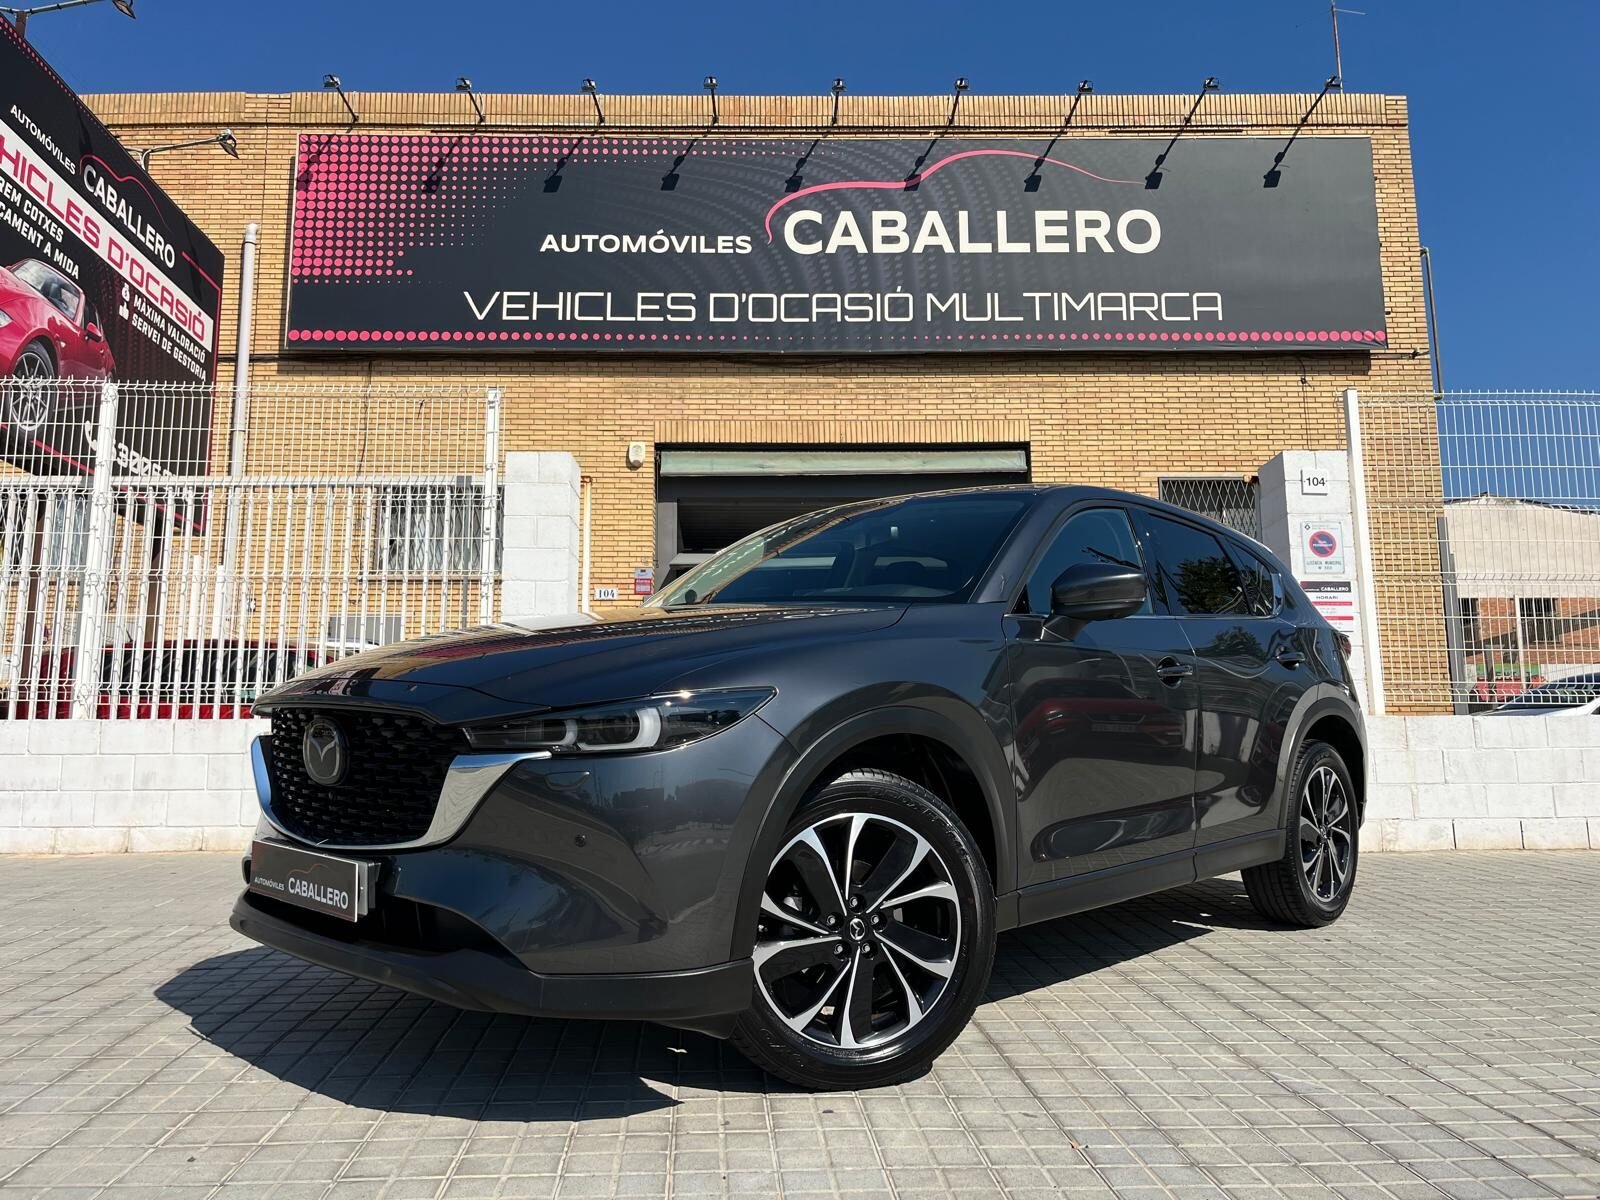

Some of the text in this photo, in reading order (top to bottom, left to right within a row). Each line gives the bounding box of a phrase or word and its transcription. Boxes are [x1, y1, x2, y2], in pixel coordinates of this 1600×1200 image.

[11, 104, 175, 269] AUTOMÓVILES CABALLERO
[23, 200, 64, 243] COTXES
[539, 209, 1162, 255] AUTOMÓVILES CABALLERO
[43, 241, 52, 257] A
[54, 248, 79, 280] MIDA
[107, 236, 205, 343] D'OCASIÓ
[464, 286, 1223, 323] VEHICLES D'OCASIÓ MULTIMARCA
[131, 313, 206, 382] SERVEI DE GESTORIA
[167, 322, 206, 364] VALORACIÓ
[1306, 477, 1326, 487] 104
[599, 589, 615, 599] 104
[254, 876, 349, 909] AUTOMÓVILES CABALLERO
